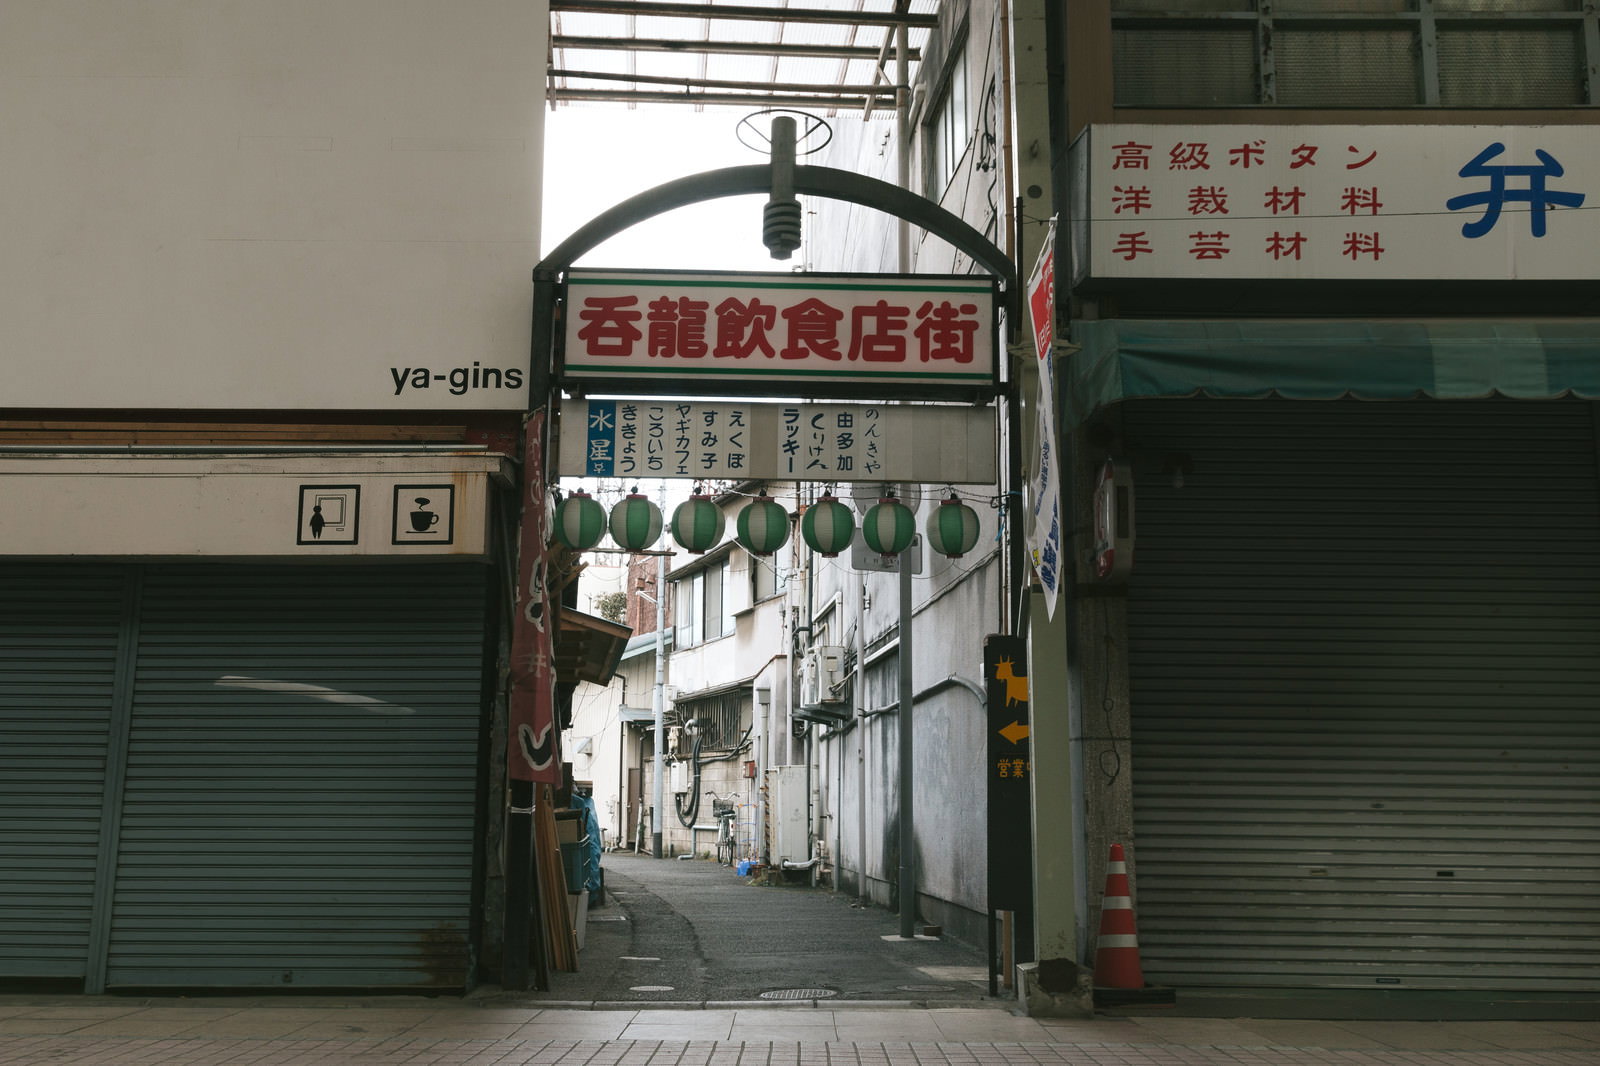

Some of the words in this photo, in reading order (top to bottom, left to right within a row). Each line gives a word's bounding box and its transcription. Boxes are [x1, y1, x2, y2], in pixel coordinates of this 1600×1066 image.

[1111, 139, 1378, 171] 高級ボタン
[1111, 185, 1385, 216] 洋裁材料
[1447, 142, 1586, 239] 弁
[1111, 231, 1386, 261] 手芸材料
[577, 295, 980, 364] 呑龍飲食店街
[390, 361, 523, 396] ya-gins
[620, 404, 638, 473] ききょう
[647, 407, 664, 471] ころいち
[674, 404, 692, 475] ヤギカフェ
[701, 410, 719, 469] すみ子
[727, 410, 746, 469] えくぼ
[782, 408, 800, 473] ラッキー
[836, 411, 854, 471] 由多加
[864, 408, 881, 474] のんきや
